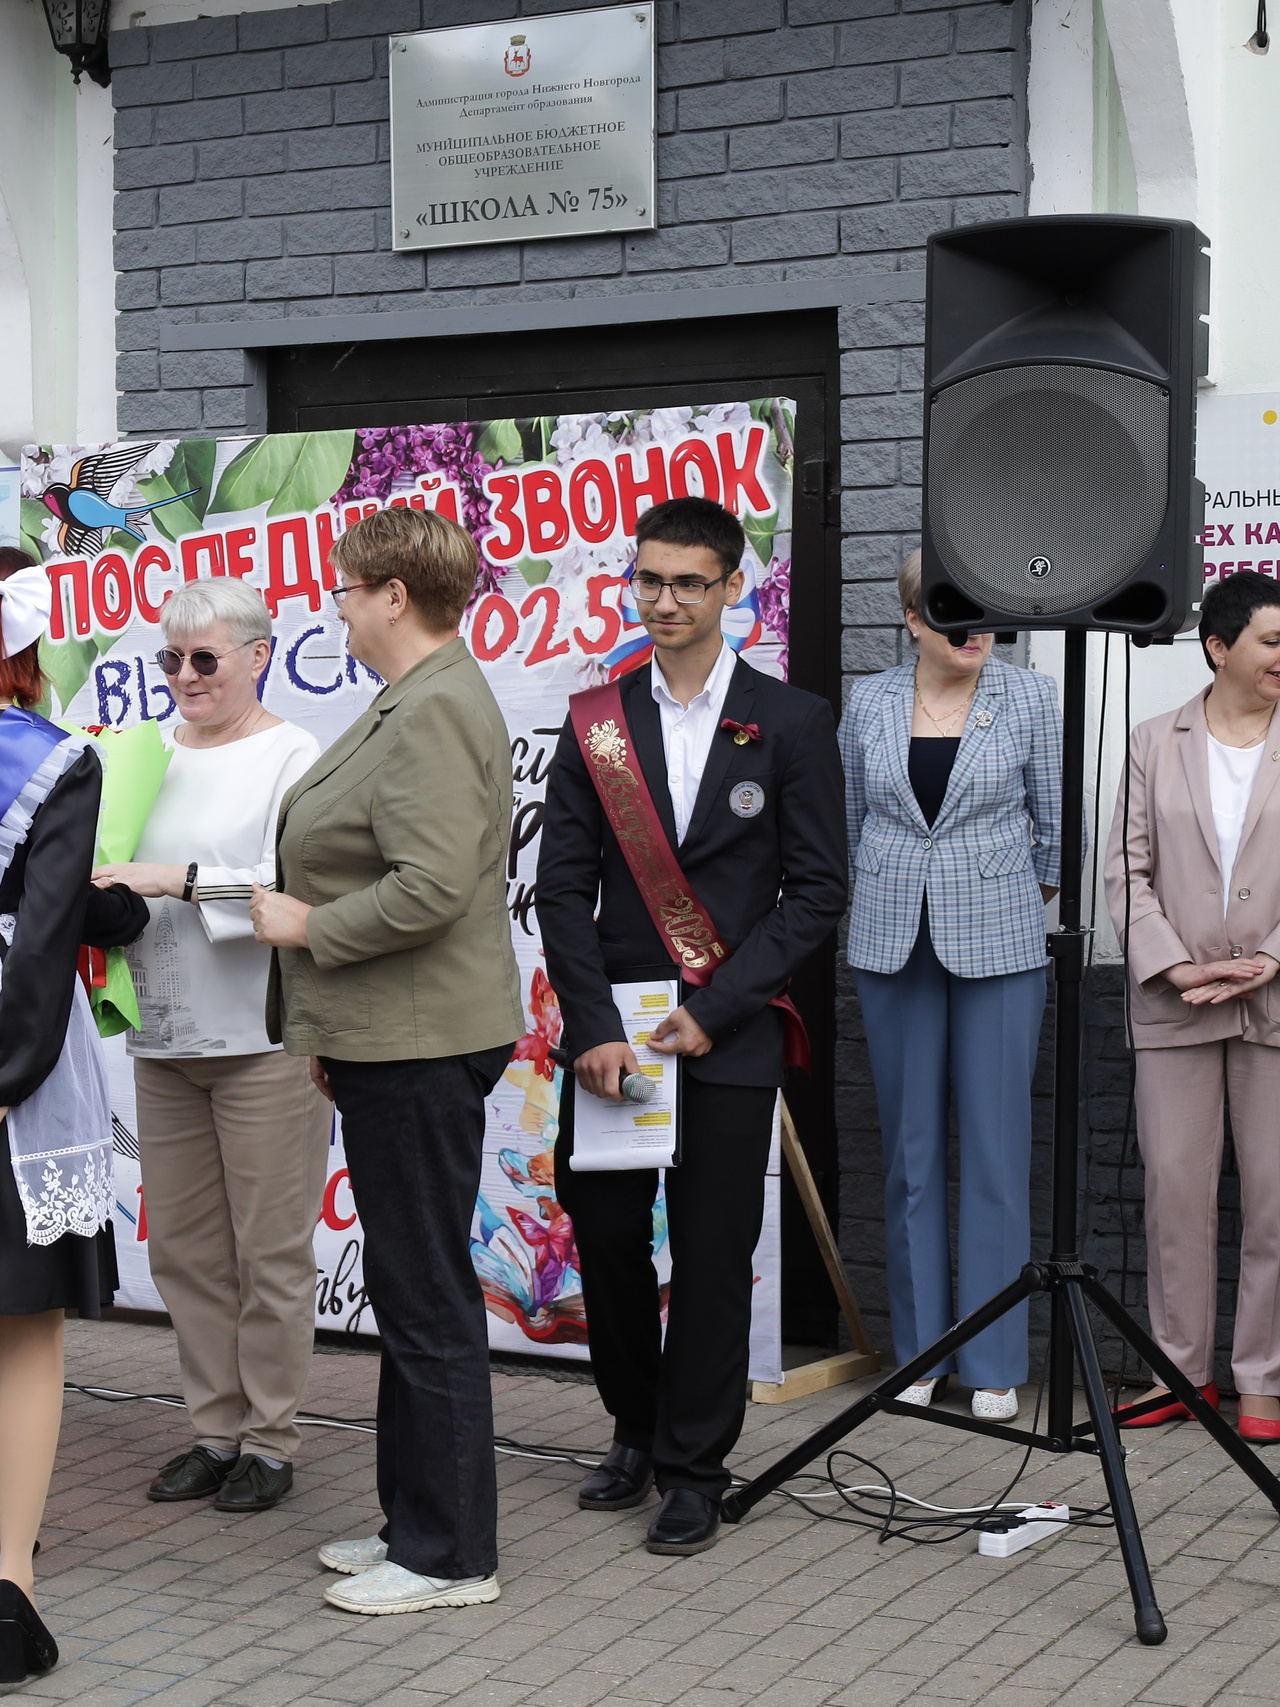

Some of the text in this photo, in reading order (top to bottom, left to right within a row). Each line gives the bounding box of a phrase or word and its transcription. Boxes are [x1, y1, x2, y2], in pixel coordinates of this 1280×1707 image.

[416, 75, 641, 108] Администрация города Нижнего Новгорода
[459, 95, 593, 119] Департамент образования
[536, 121, 626, 140] БЮДЖЕТНОЕ
[438, 140, 601, 167] ОБЩЕОБРАЗОВАТЕЛЬНОЕ
[474, 159, 564, 178] УЧРЕЖДЕНИЕ
[415, 186, 629, 227] «ШКОЛА № 75»
[486, 427, 771, 560] ЗВОНОК
[455, 574, 629, 668] 025
[655, 896, 725, 969] 2025
